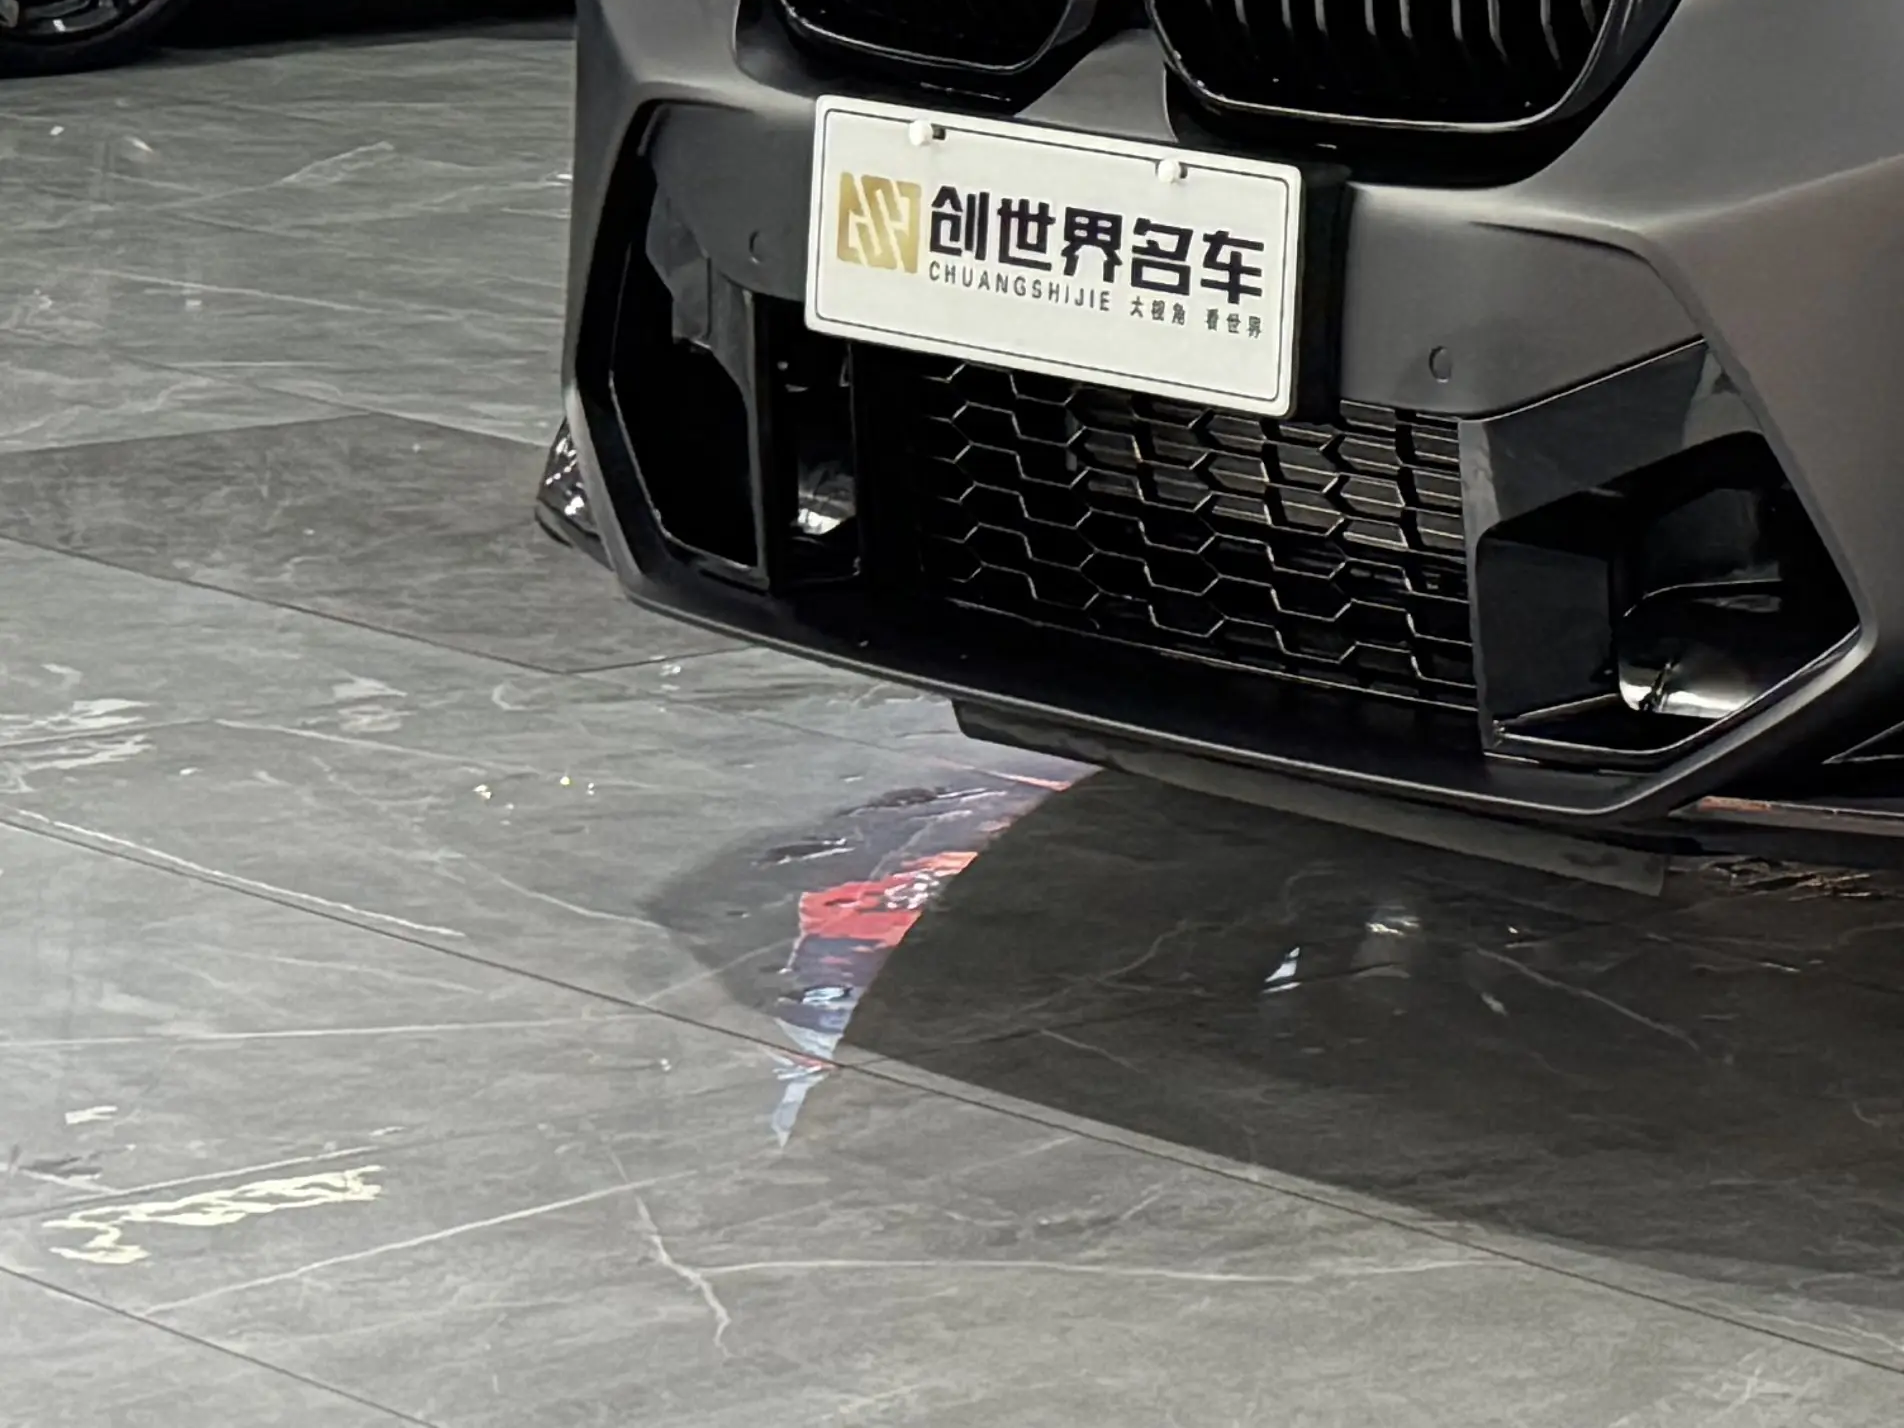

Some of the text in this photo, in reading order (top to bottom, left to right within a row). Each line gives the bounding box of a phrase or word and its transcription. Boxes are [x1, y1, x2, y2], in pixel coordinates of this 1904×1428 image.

[929, 184, 1265, 306] 创世界名车
[929, 260, 1112, 312] CHUANGSHIJIE
[1130, 295, 1187, 326] 大视角
